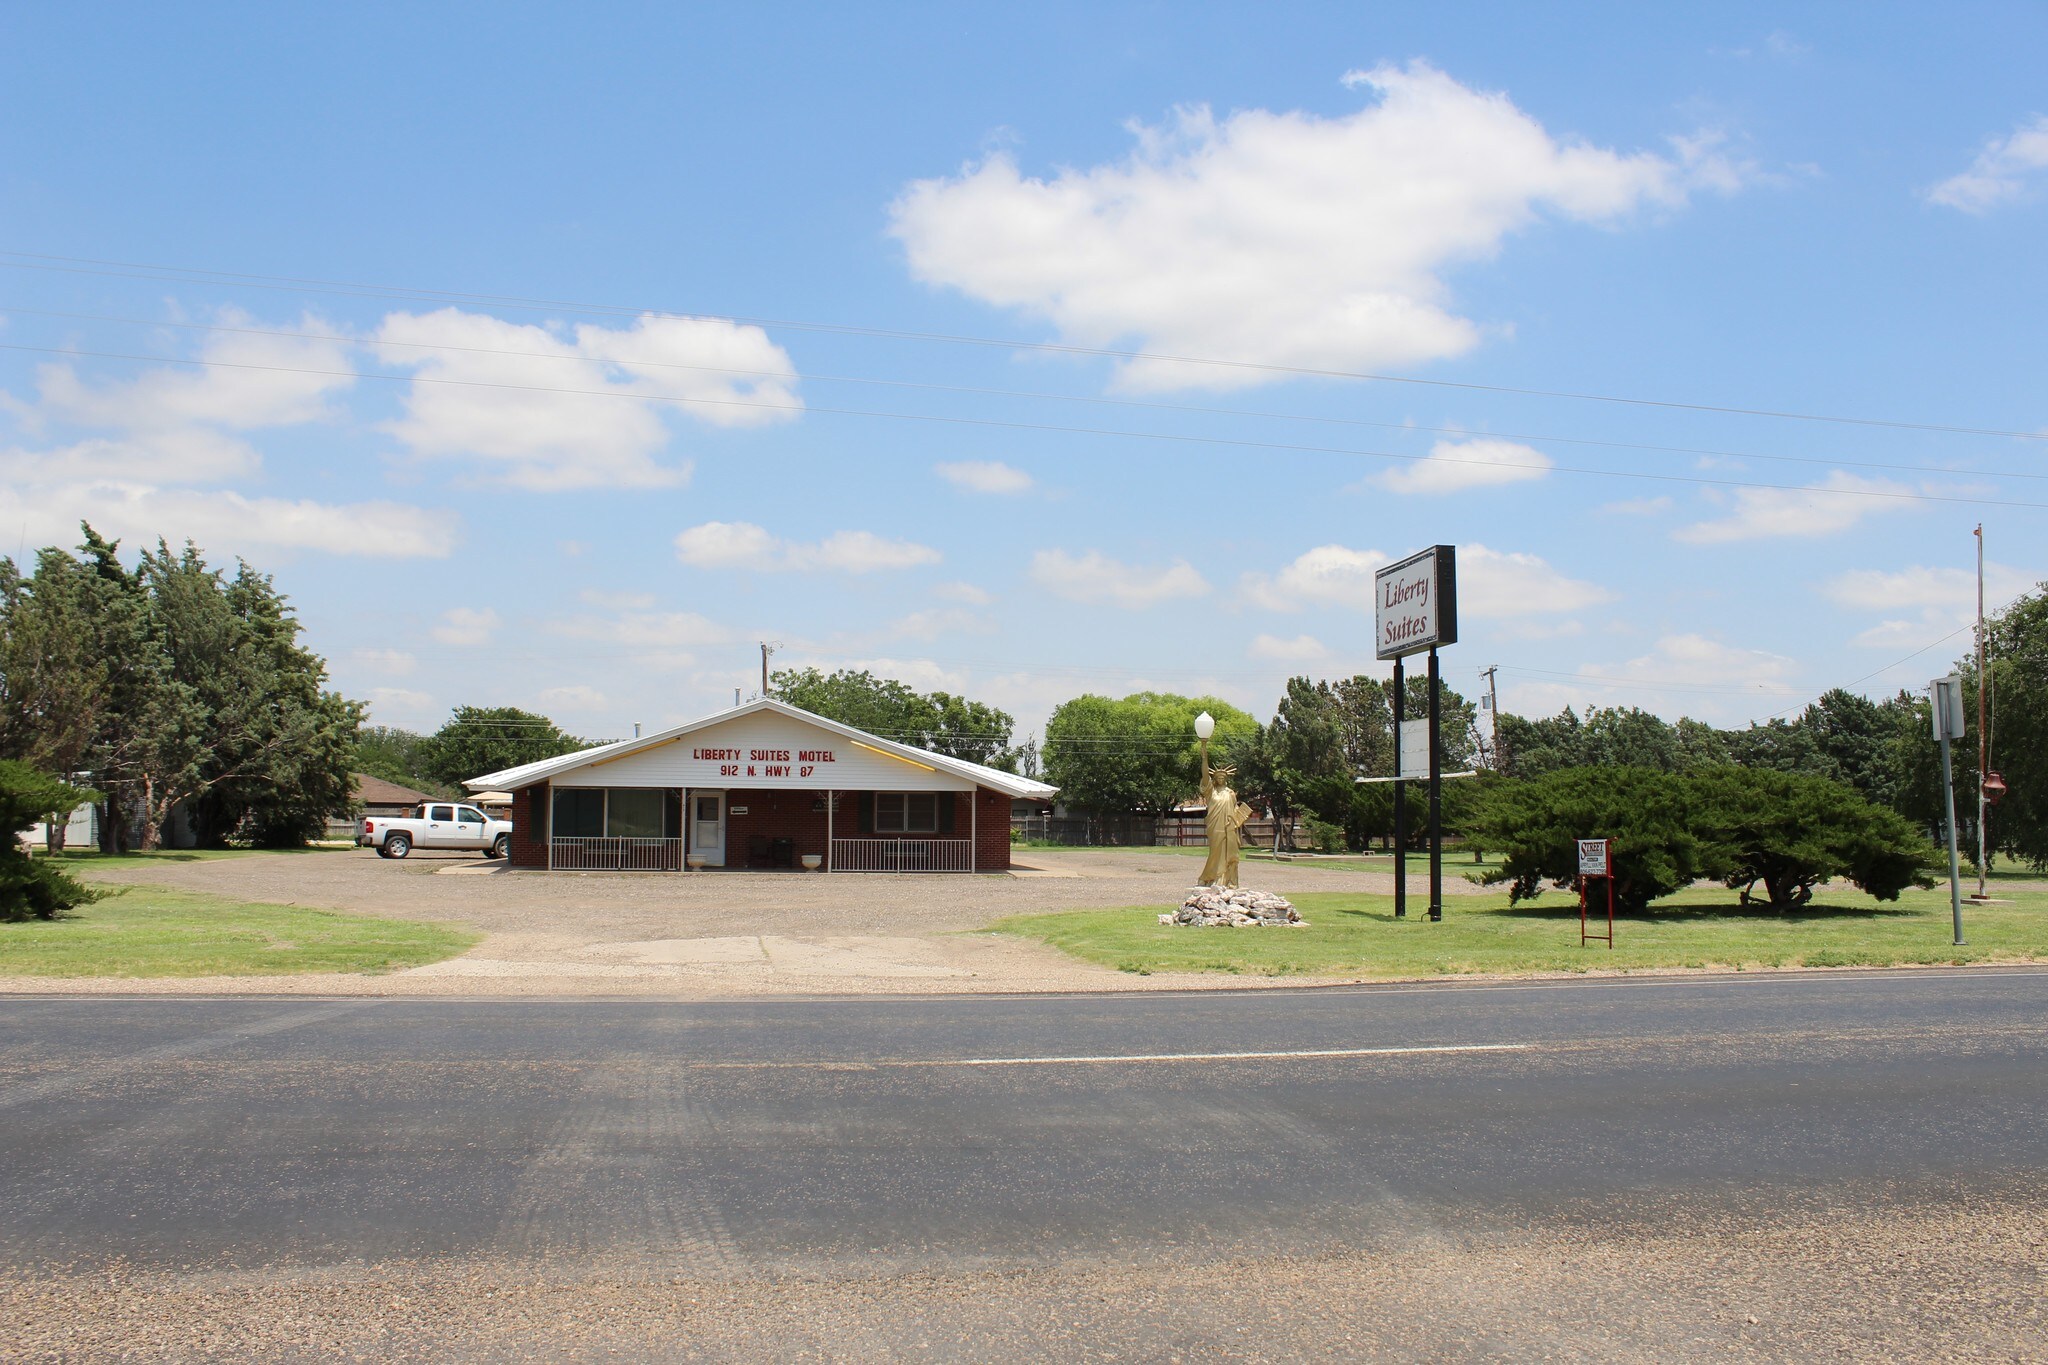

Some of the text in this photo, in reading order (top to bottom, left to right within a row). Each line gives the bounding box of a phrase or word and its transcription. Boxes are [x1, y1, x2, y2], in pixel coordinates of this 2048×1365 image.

[1385, 577, 1429, 609] Liberty
[1385, 616, 1427, 645] Suites
[693, 749, 835, 762] LIBERTY SUITES MOTEL
[720, 765, 814, 777] 912 N. HWY 87
